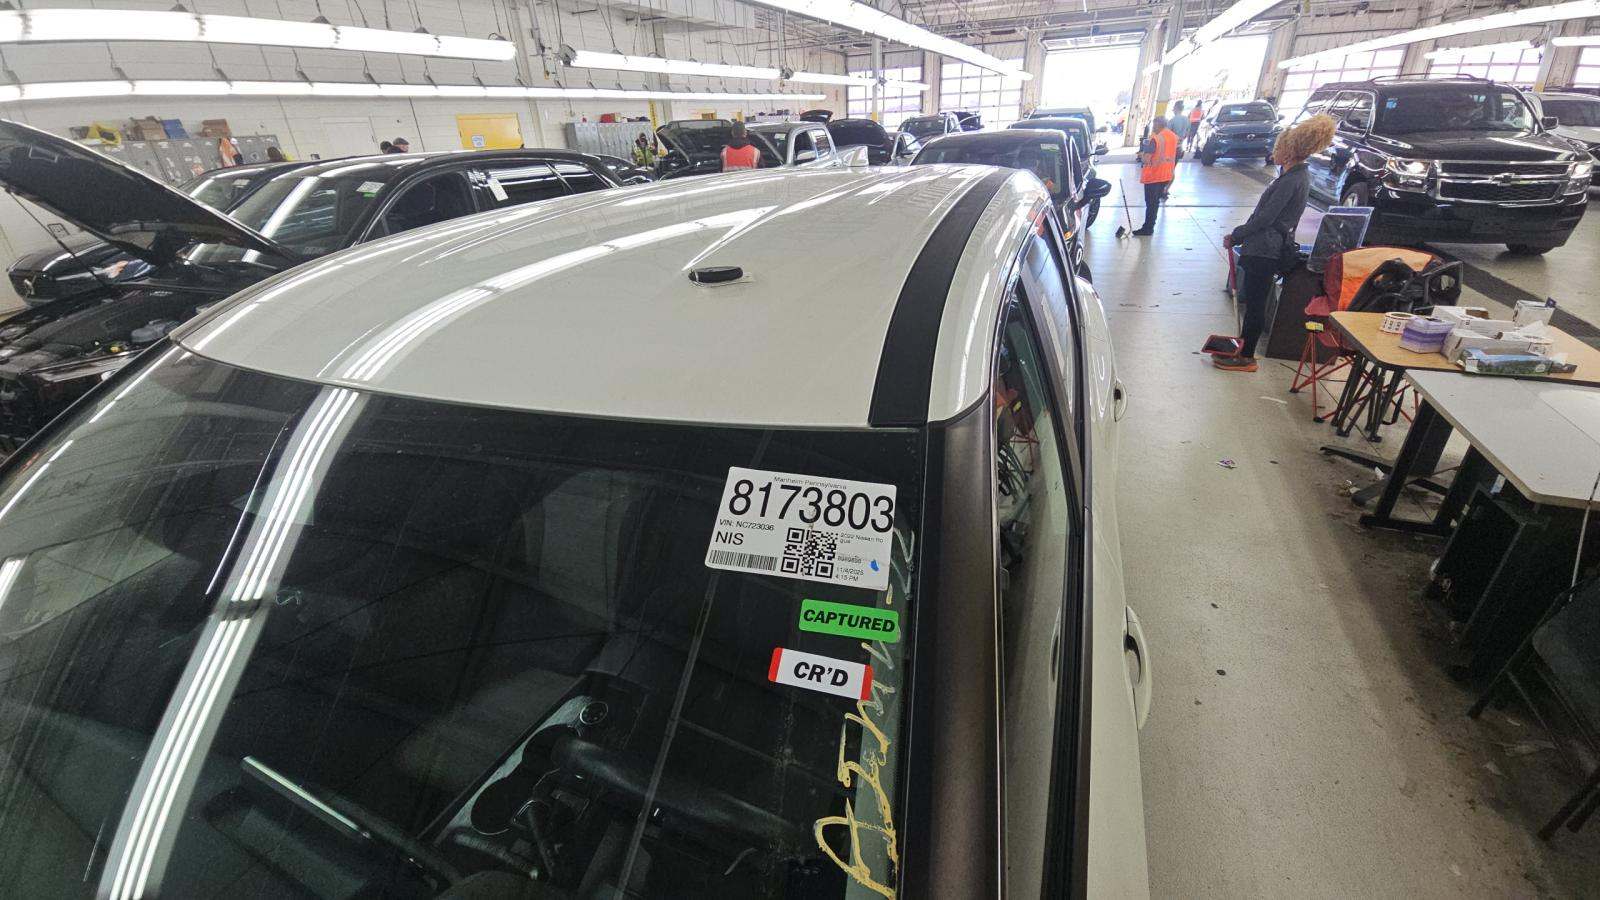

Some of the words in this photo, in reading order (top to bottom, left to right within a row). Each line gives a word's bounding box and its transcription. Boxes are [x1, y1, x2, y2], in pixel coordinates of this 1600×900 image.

[804, 479, 847, 490] Pennsylvania
[729, 479, 894, 533] 8173803
[719, 518, 733, 527] VIN:
[736, 520, 775, 531] NC723036
[715, 531, 744, 545] NIS
[803, 608, 896, 634] CAPTURED
[793, 661, 849, 687] CR'D
